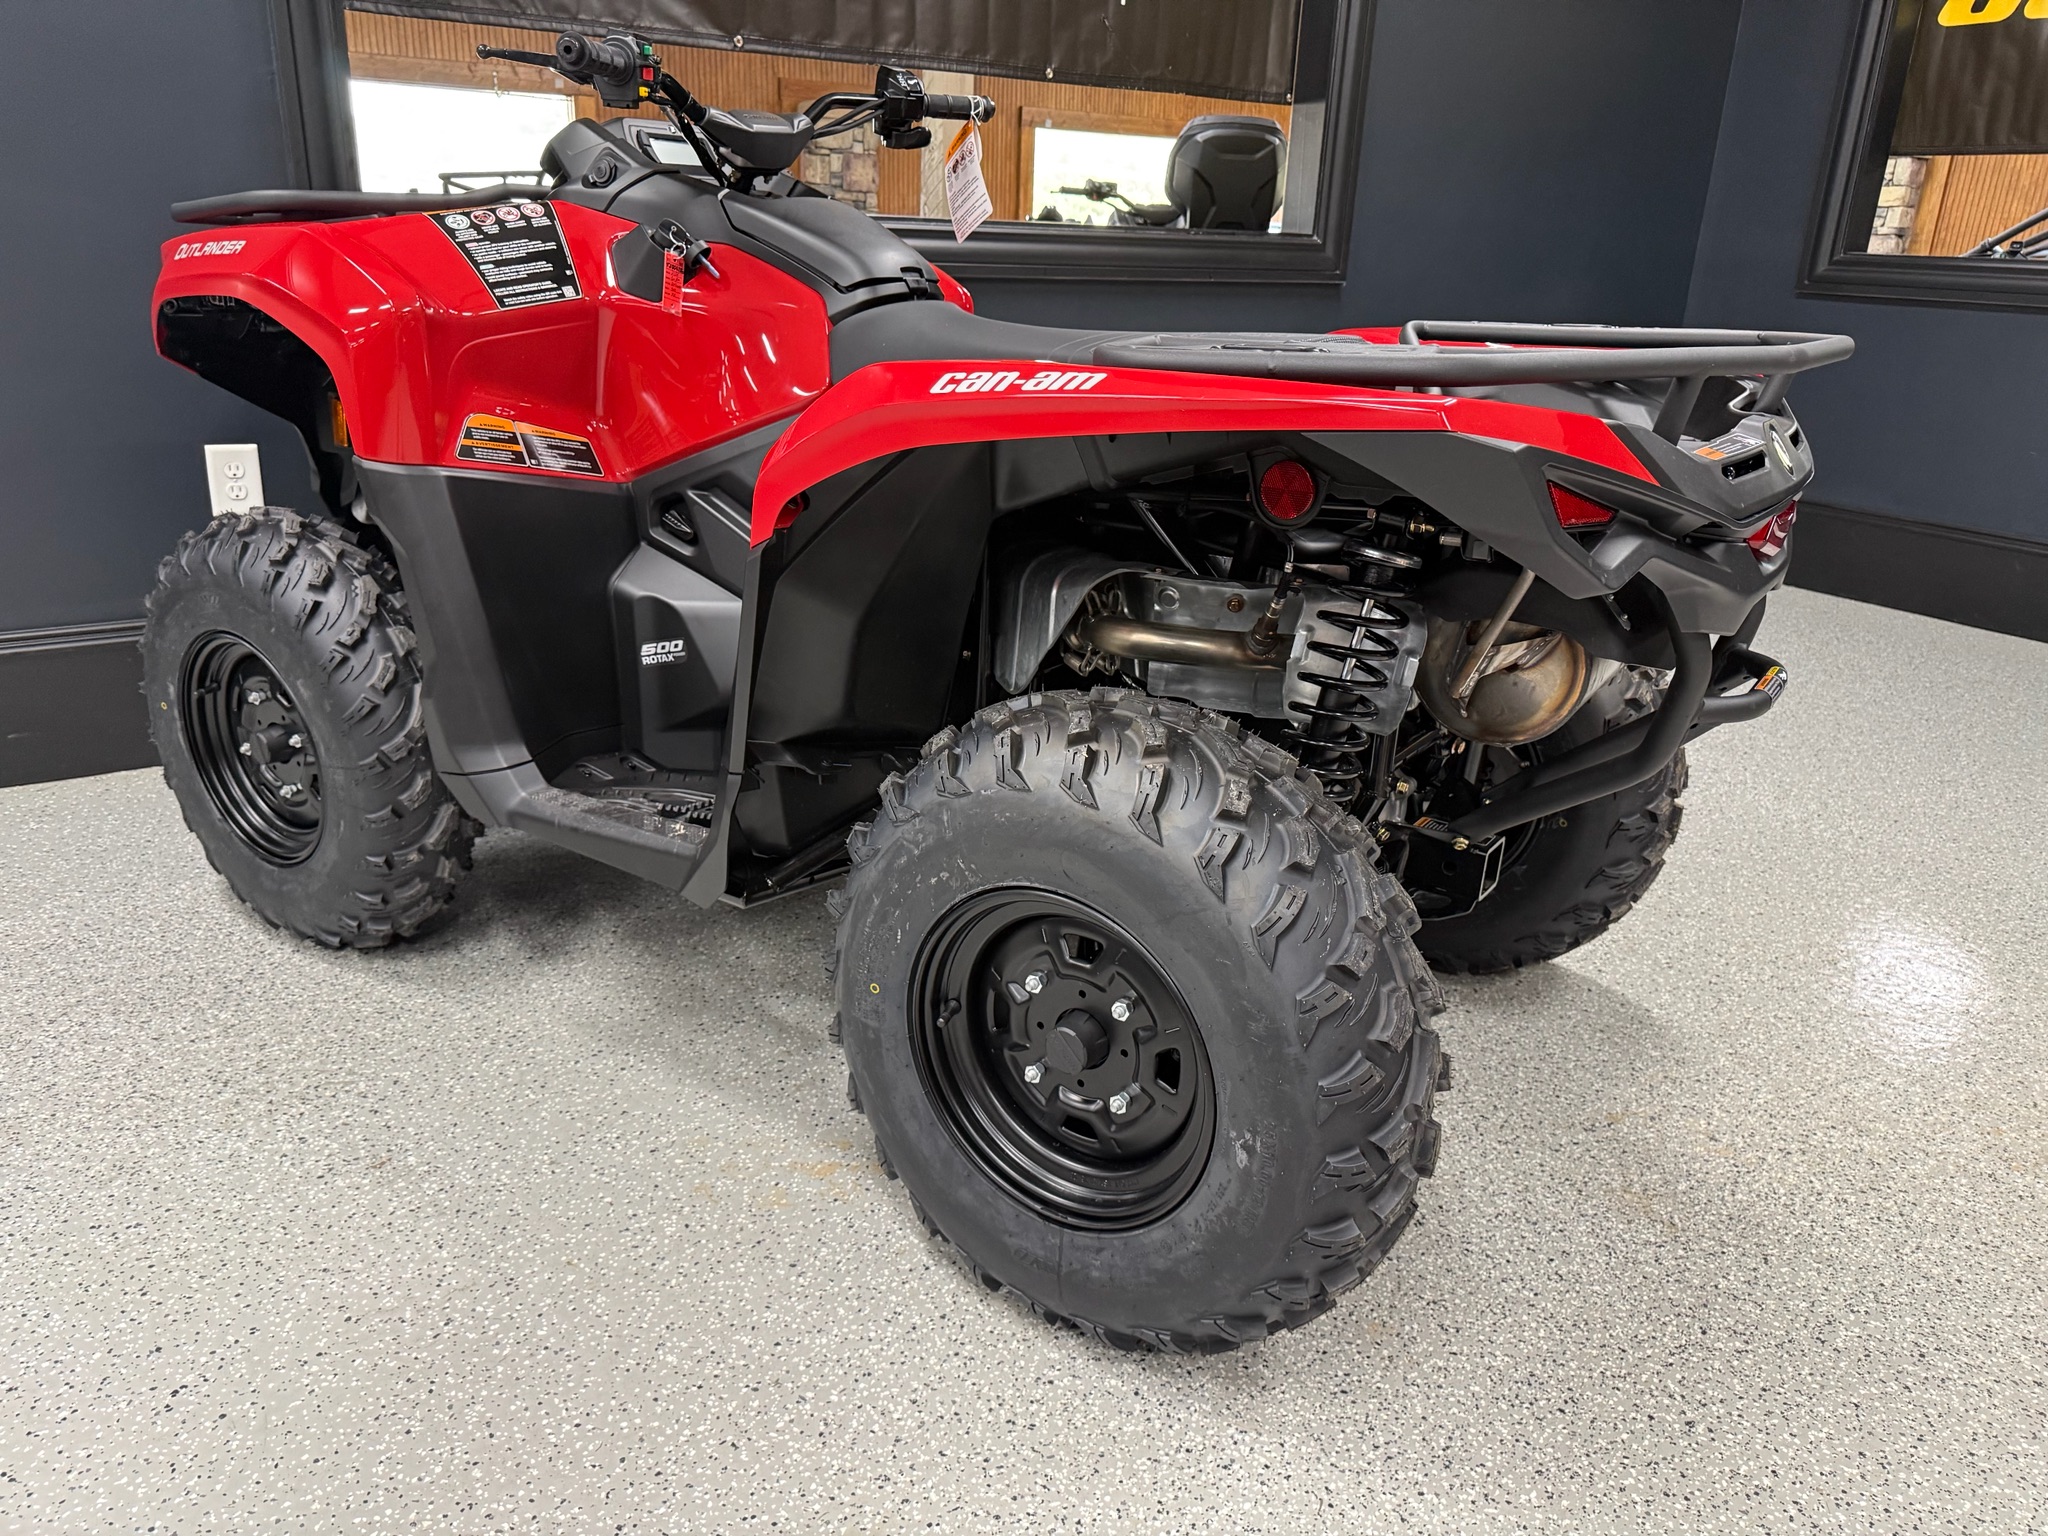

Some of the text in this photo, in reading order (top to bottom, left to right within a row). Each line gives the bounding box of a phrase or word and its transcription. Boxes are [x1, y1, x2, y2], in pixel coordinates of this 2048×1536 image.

[173, 240, 247, 260] OUTLANDER
[929, 371, 1107, 394] can-am
[641, 640, 684, 656] 500
[641, 653, 675, 665] ROTAX
